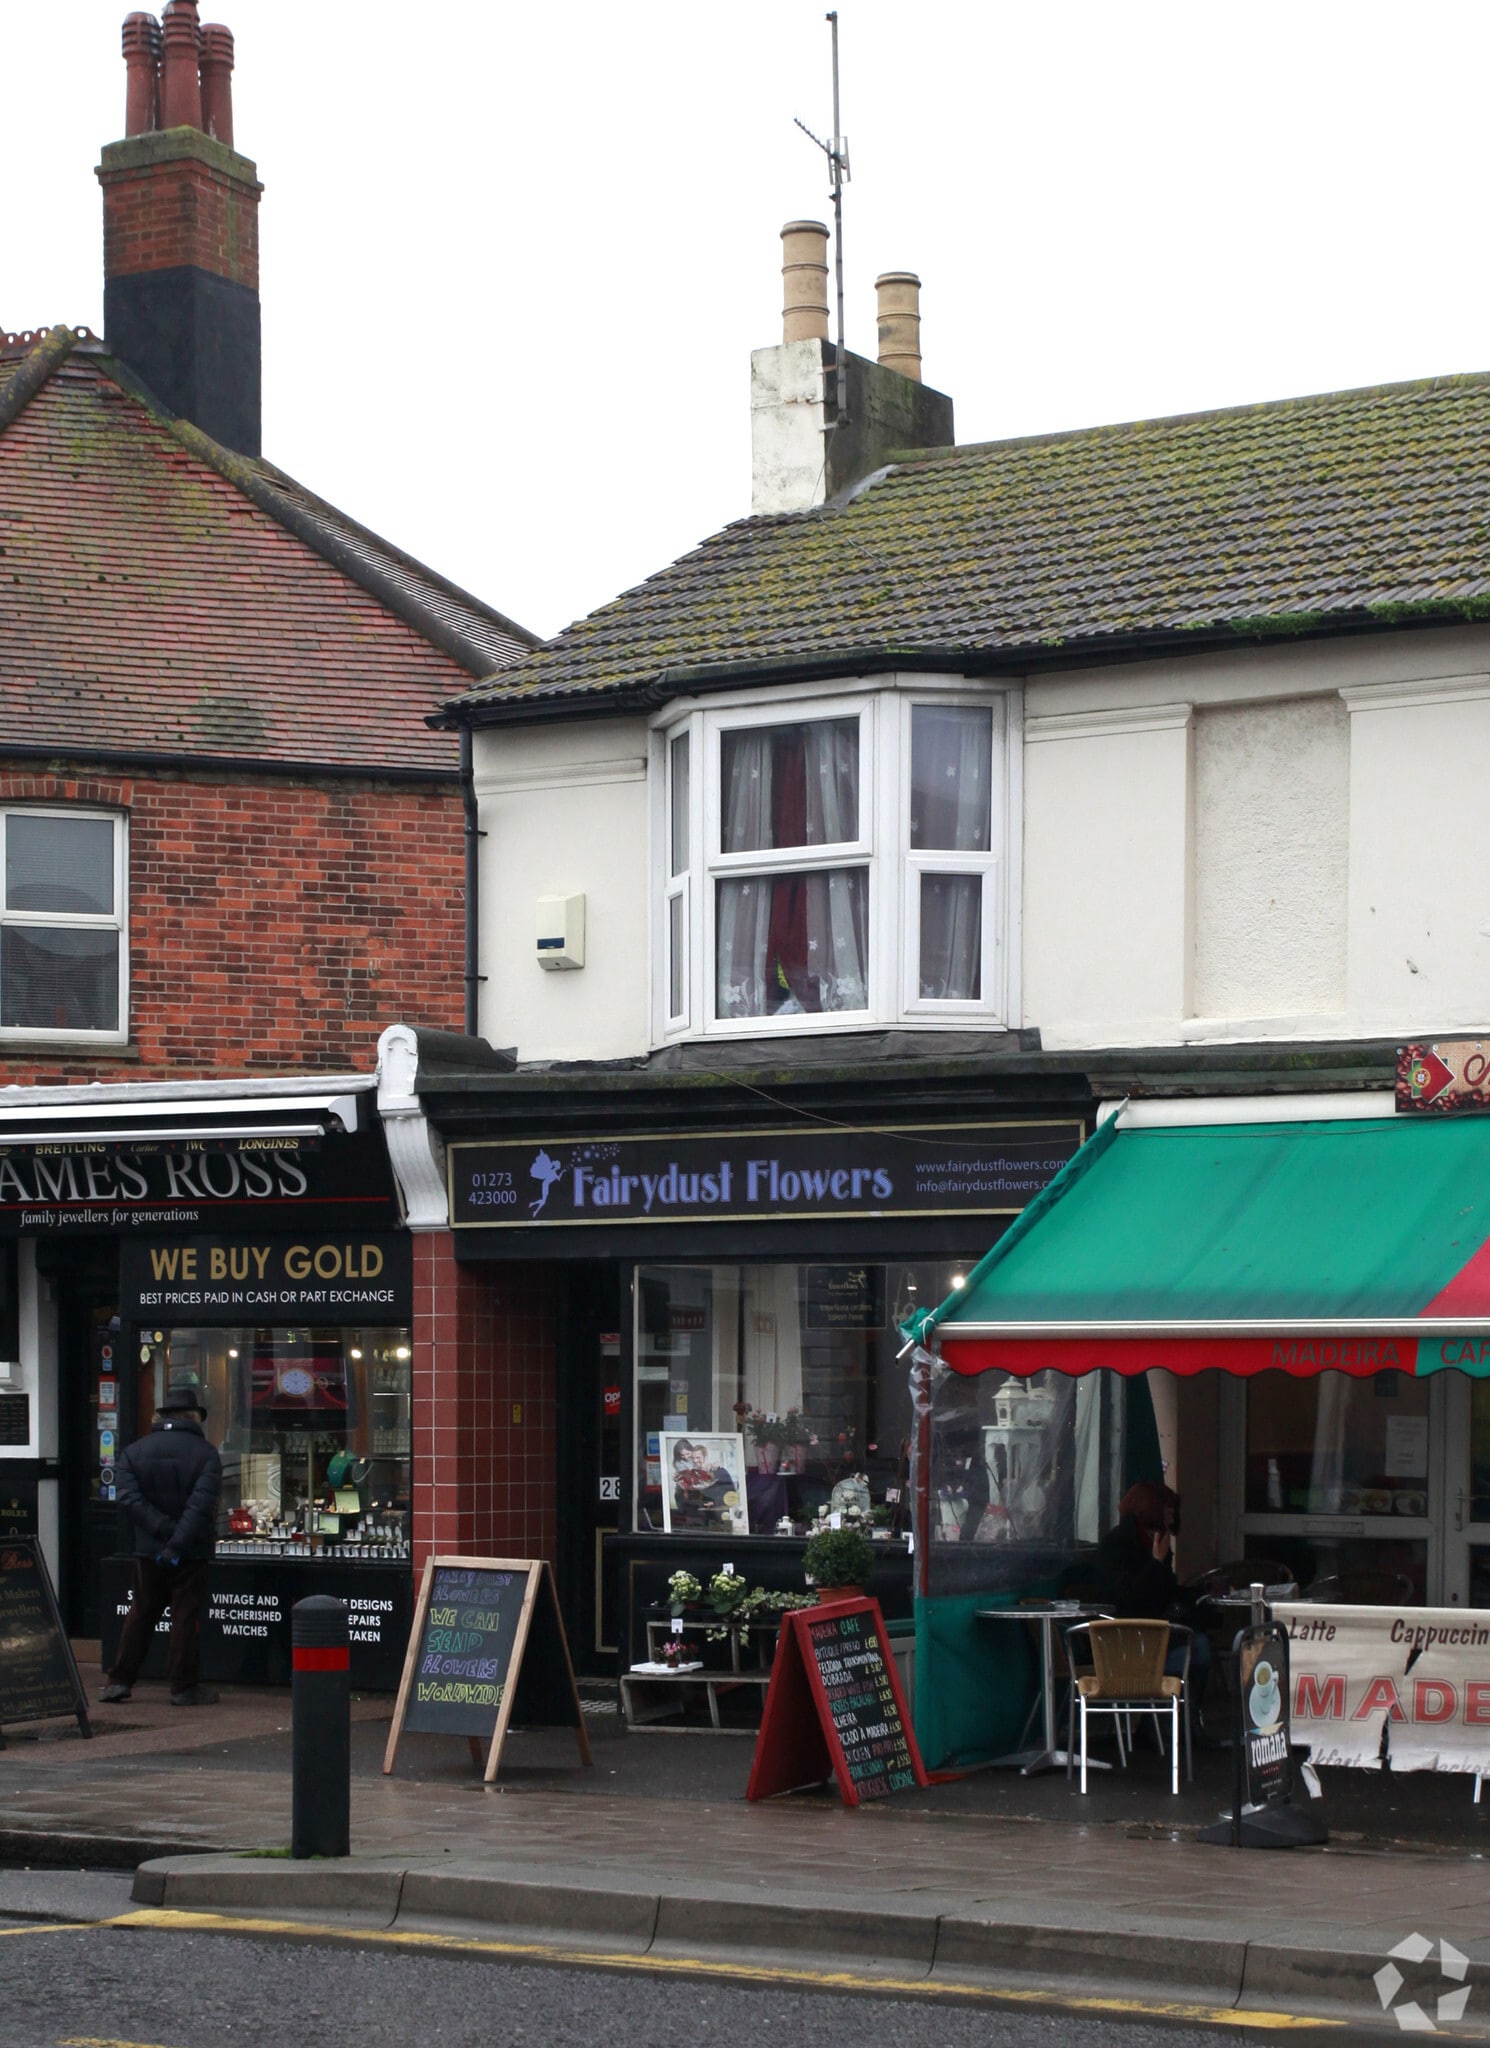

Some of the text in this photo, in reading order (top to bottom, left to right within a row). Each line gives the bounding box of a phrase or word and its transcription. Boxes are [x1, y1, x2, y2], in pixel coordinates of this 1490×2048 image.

[35, 1143, 106, 1155] BREITLING
[238, 1138, 299, 1150] LONGINES
[166, 1152, 308, 1199] ROSS
[471, 1171, 513, 1187] 01273
[573, 1160, 893, 1213] Fairydust Flowers
[468, 1189, 517, 1205] 423000
[19, 1207, 199, 1228] family jewellers for generations
[150, 1244, 383, 1281] WE BUY GOLD
[140, 1289, 394, 1304] BEST PRICES PAID IN CASH OR PART EXCHANGE
[1272, 1341, 1400, 1367] MADEIRA
[211, 1593, 279, 1607] VINTAGE AND
[350, 1599, 393, 1612] DESIGNS
[208, 1608, 282, 1622] PRE-CHERISHED
[347, 1614, 381, 1627] EPAIRS
[430, 1608, 500, 1632] WE CAN
[222, 1623, 268, 1637] WATCHES
[1289, 1616, 1337, 1642] Latte
[427, 1629, 483, 1654] SEND
[422, 1654, 497, 1679] FLOWERS
[821, 1670, 855, 1687] DOBRADA
[417, 1682, 505, 1707] WORLDWIDE
[1250, 1731, 1288, 1768] romana
